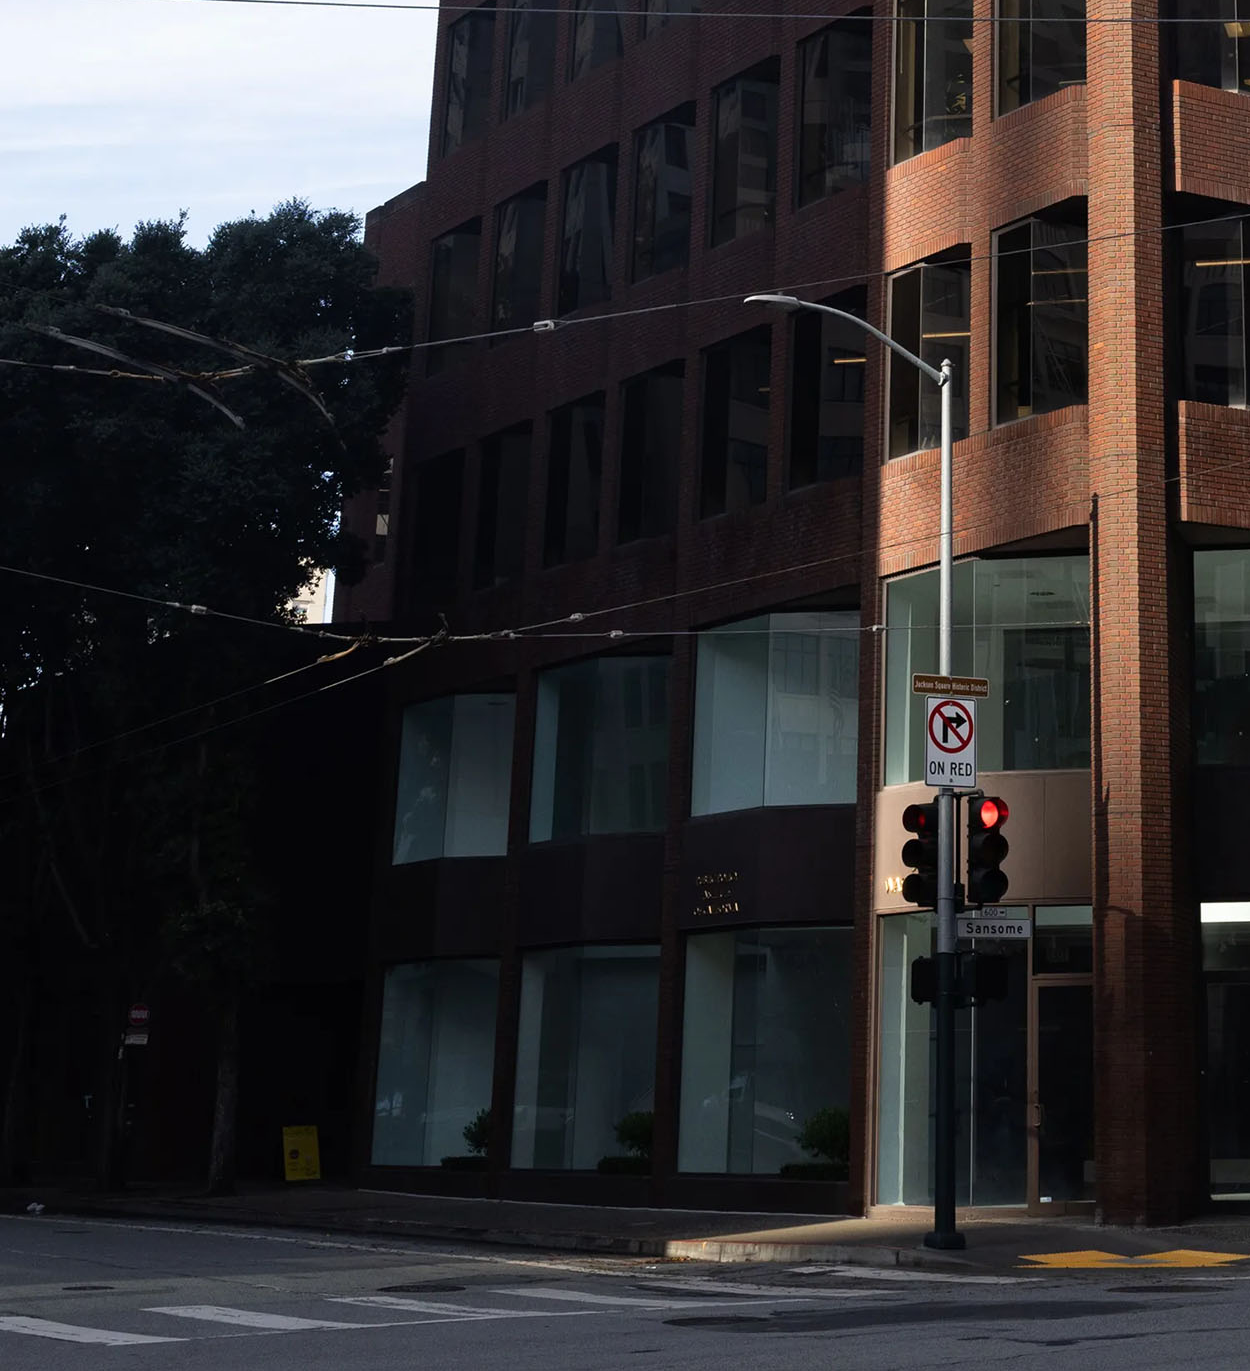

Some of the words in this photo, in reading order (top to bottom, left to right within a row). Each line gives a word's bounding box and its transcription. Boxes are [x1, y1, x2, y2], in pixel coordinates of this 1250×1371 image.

[929, 761, 945, 775] ON
[950, 762, 973, 776] RED
[966, 923, 1023, 934] Sansome
